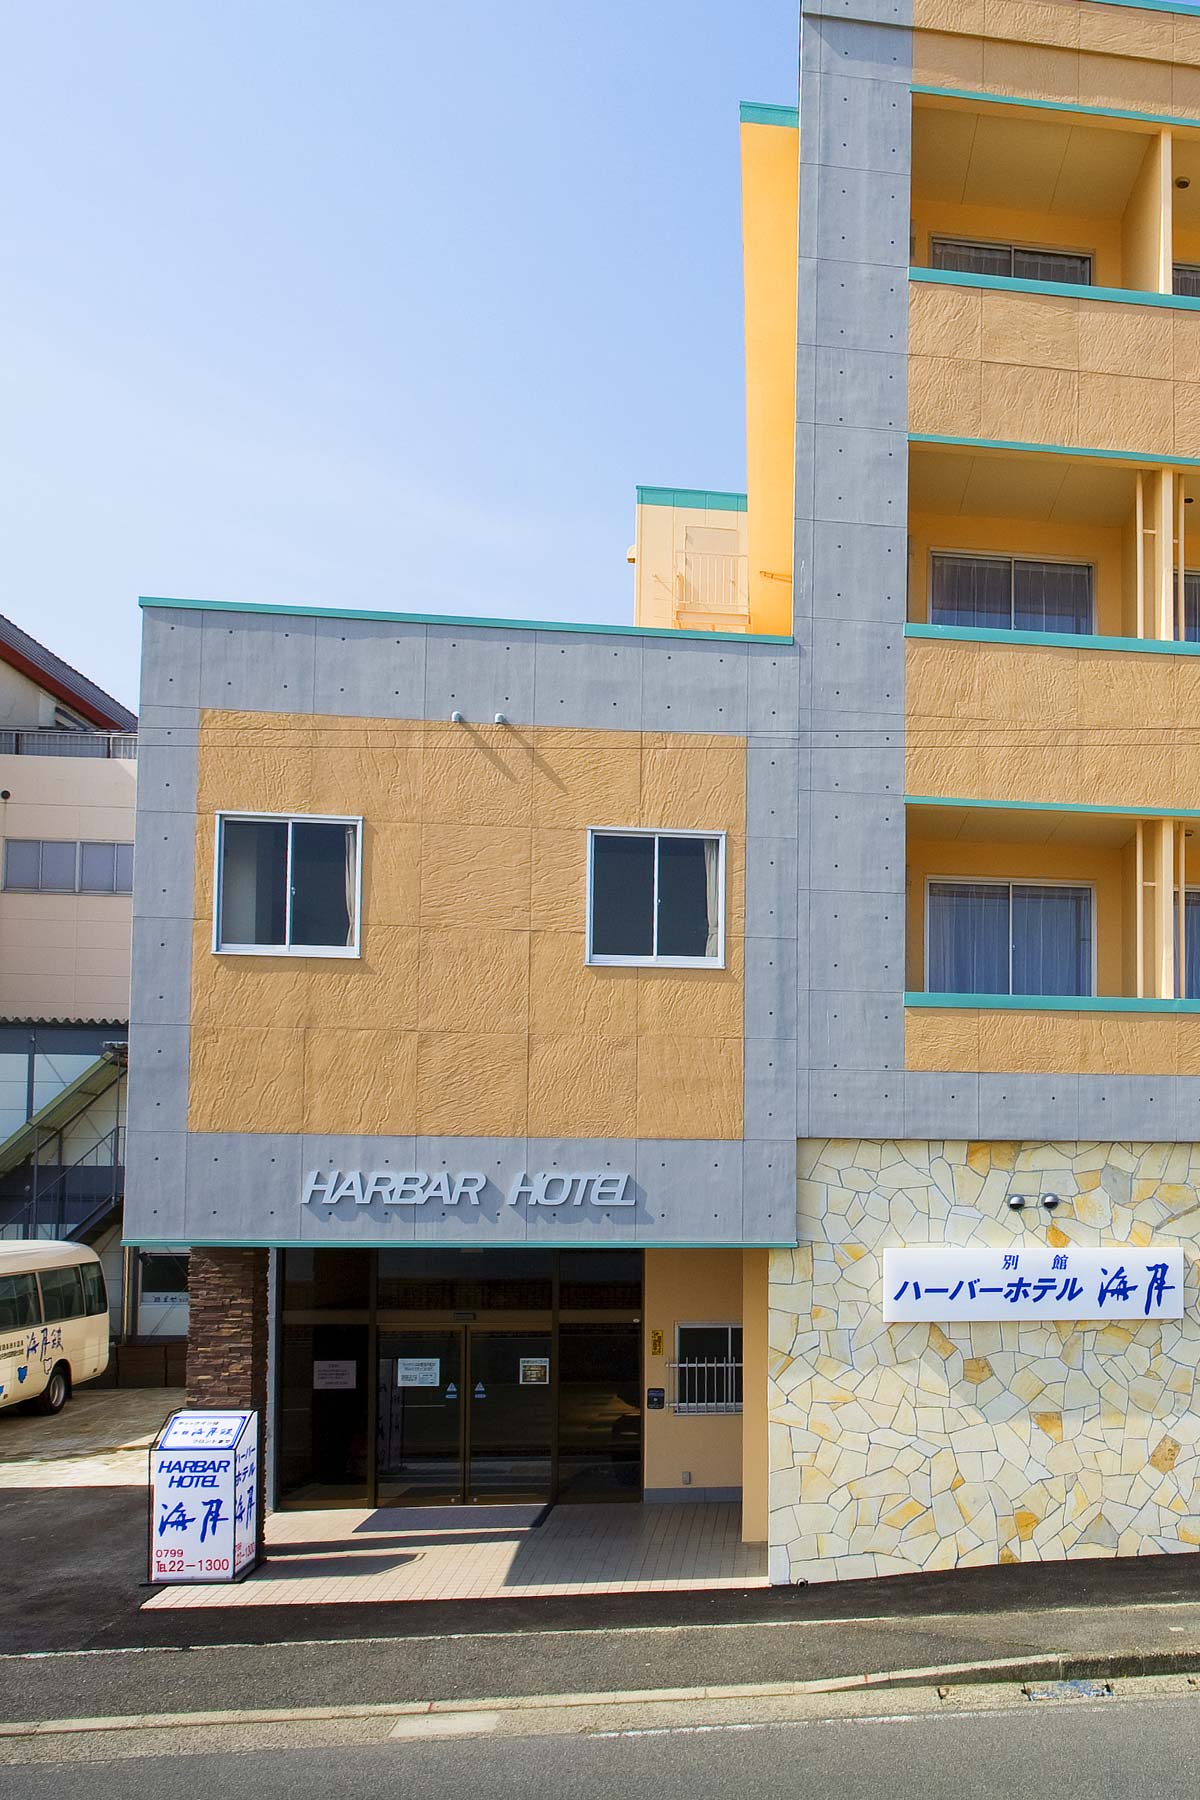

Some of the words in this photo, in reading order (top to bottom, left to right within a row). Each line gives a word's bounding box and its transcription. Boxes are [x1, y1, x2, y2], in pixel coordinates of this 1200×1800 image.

[301, 1170, 487, 1205] HARBAR
[506, 1172, 636, 1206] HOTEL
[893, 1277, 1084, 1303] ハーバーホテル
[158, 1460, 230, 1473] HARBAR
[168, 1475, 220, 1488] HOTEL
[156, 1549, 184, 1558] 0799
